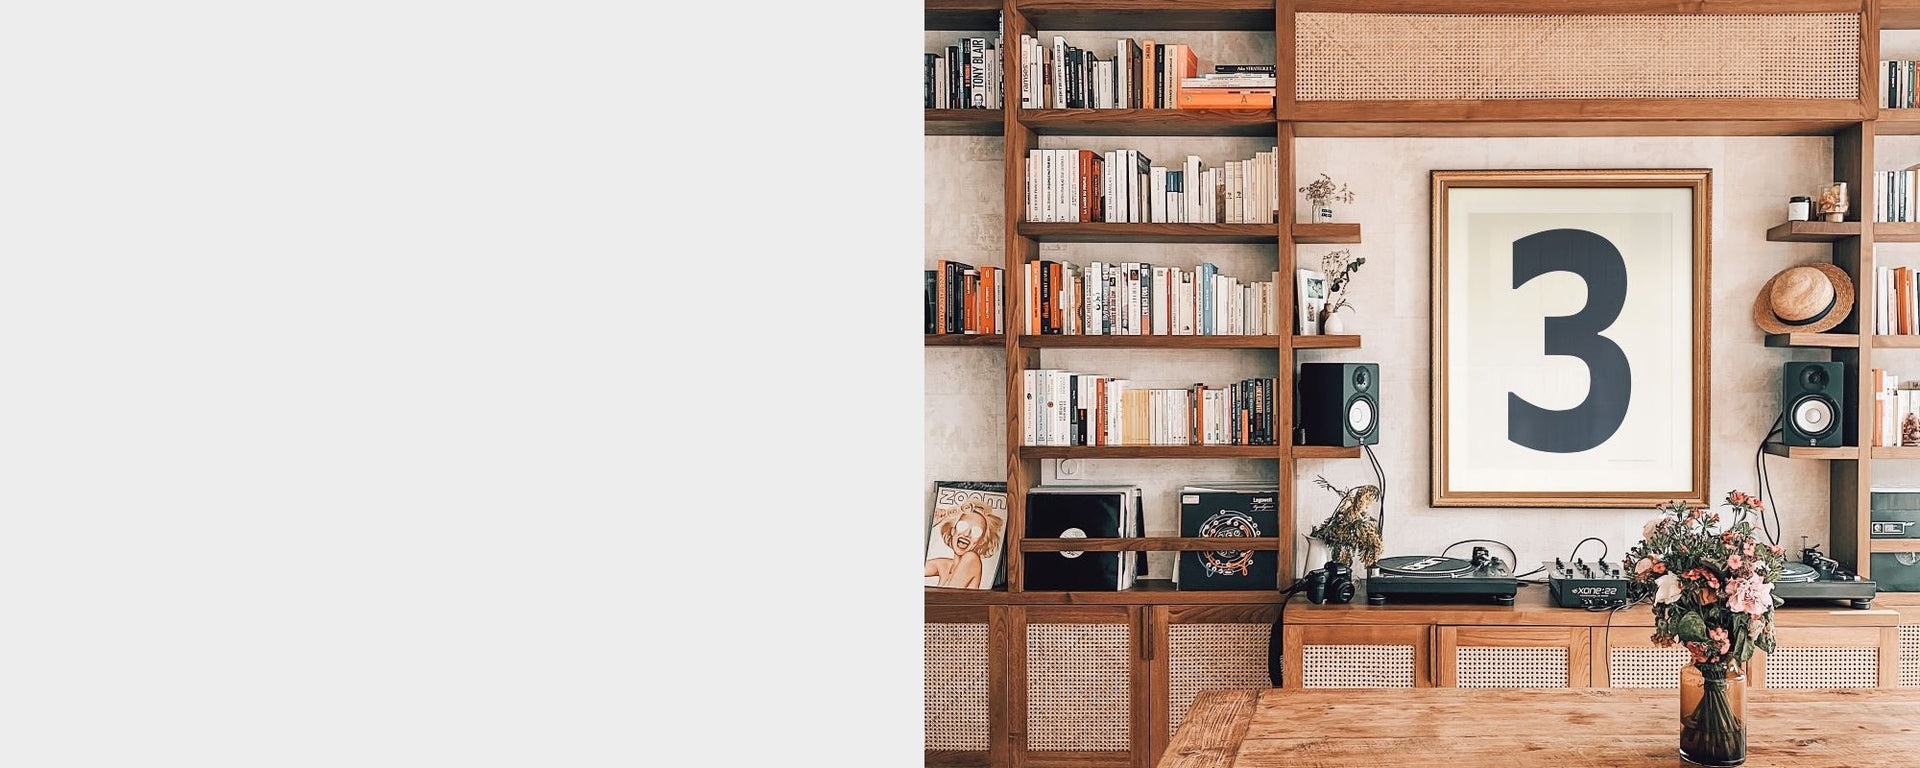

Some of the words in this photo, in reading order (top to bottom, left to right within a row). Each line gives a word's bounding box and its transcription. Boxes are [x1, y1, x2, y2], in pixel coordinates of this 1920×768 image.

[972, 40, 984, 64] BLAIR
[972, 66, 984, 88] TONY
[1508, 228, 1632, 453] 3
